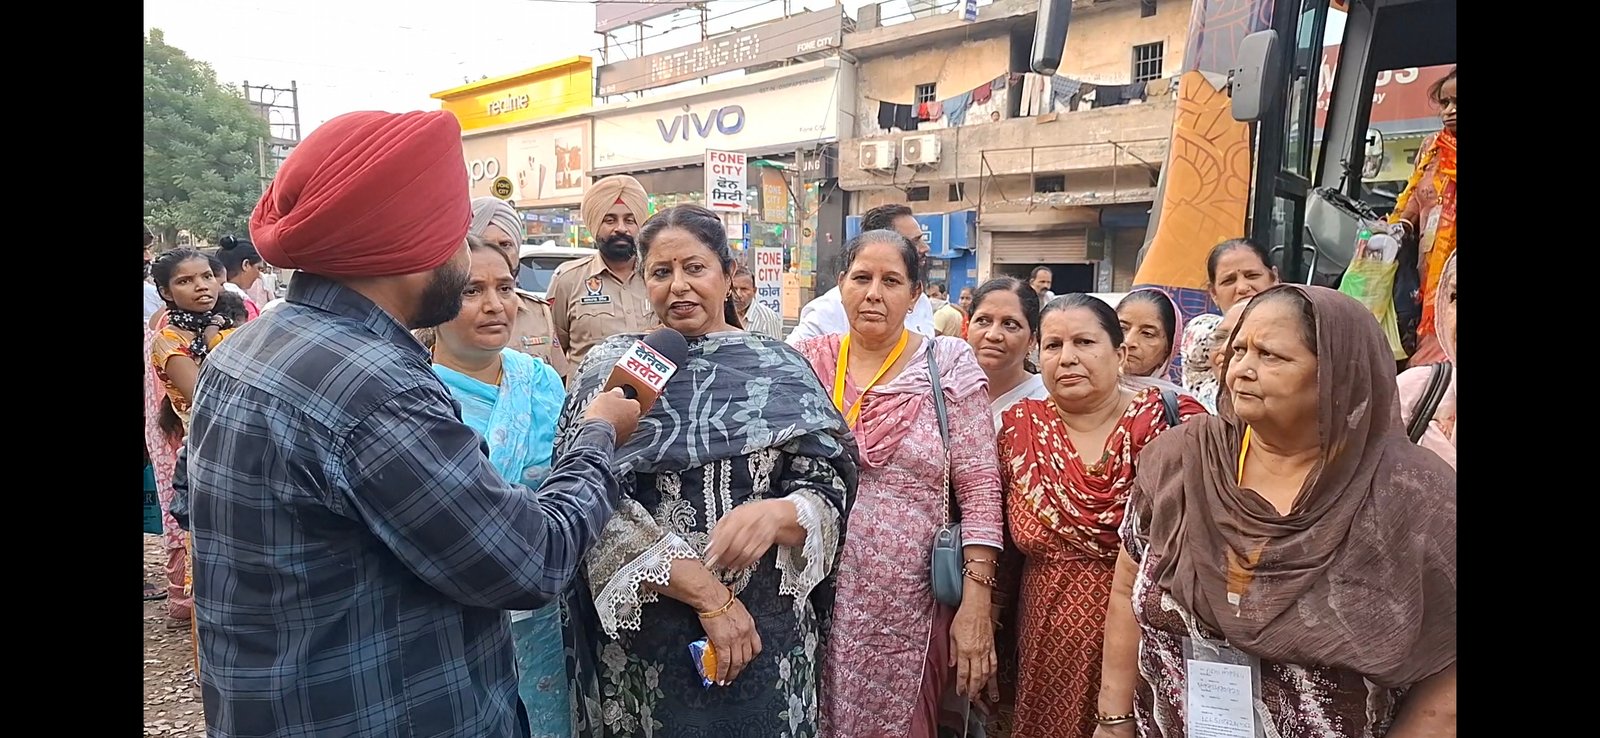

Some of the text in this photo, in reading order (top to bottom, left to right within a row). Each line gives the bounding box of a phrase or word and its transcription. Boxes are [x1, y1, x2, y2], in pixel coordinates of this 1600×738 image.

[797, 37, 833, 52] FONE CITY
[652, 34, 760, 82] NOTHING (R)
[487, 93, 529, 116] realme
[656, 104, 745, 143] vivo
[711, 152, 744, 164] FONE
[713, 164, 742, 176] CITY
[712, 188, 744, 201] ਸਿਟੀ
[764, 184, 782, 194] FONE
[757, 252, 781, 265] FONE
[758, 268, 780, 281] CITY
[758, 283, 780, 297] फोन
[635, 345, 671, 373] दैनिक
[626, 356, 663, 386] सवेरा
